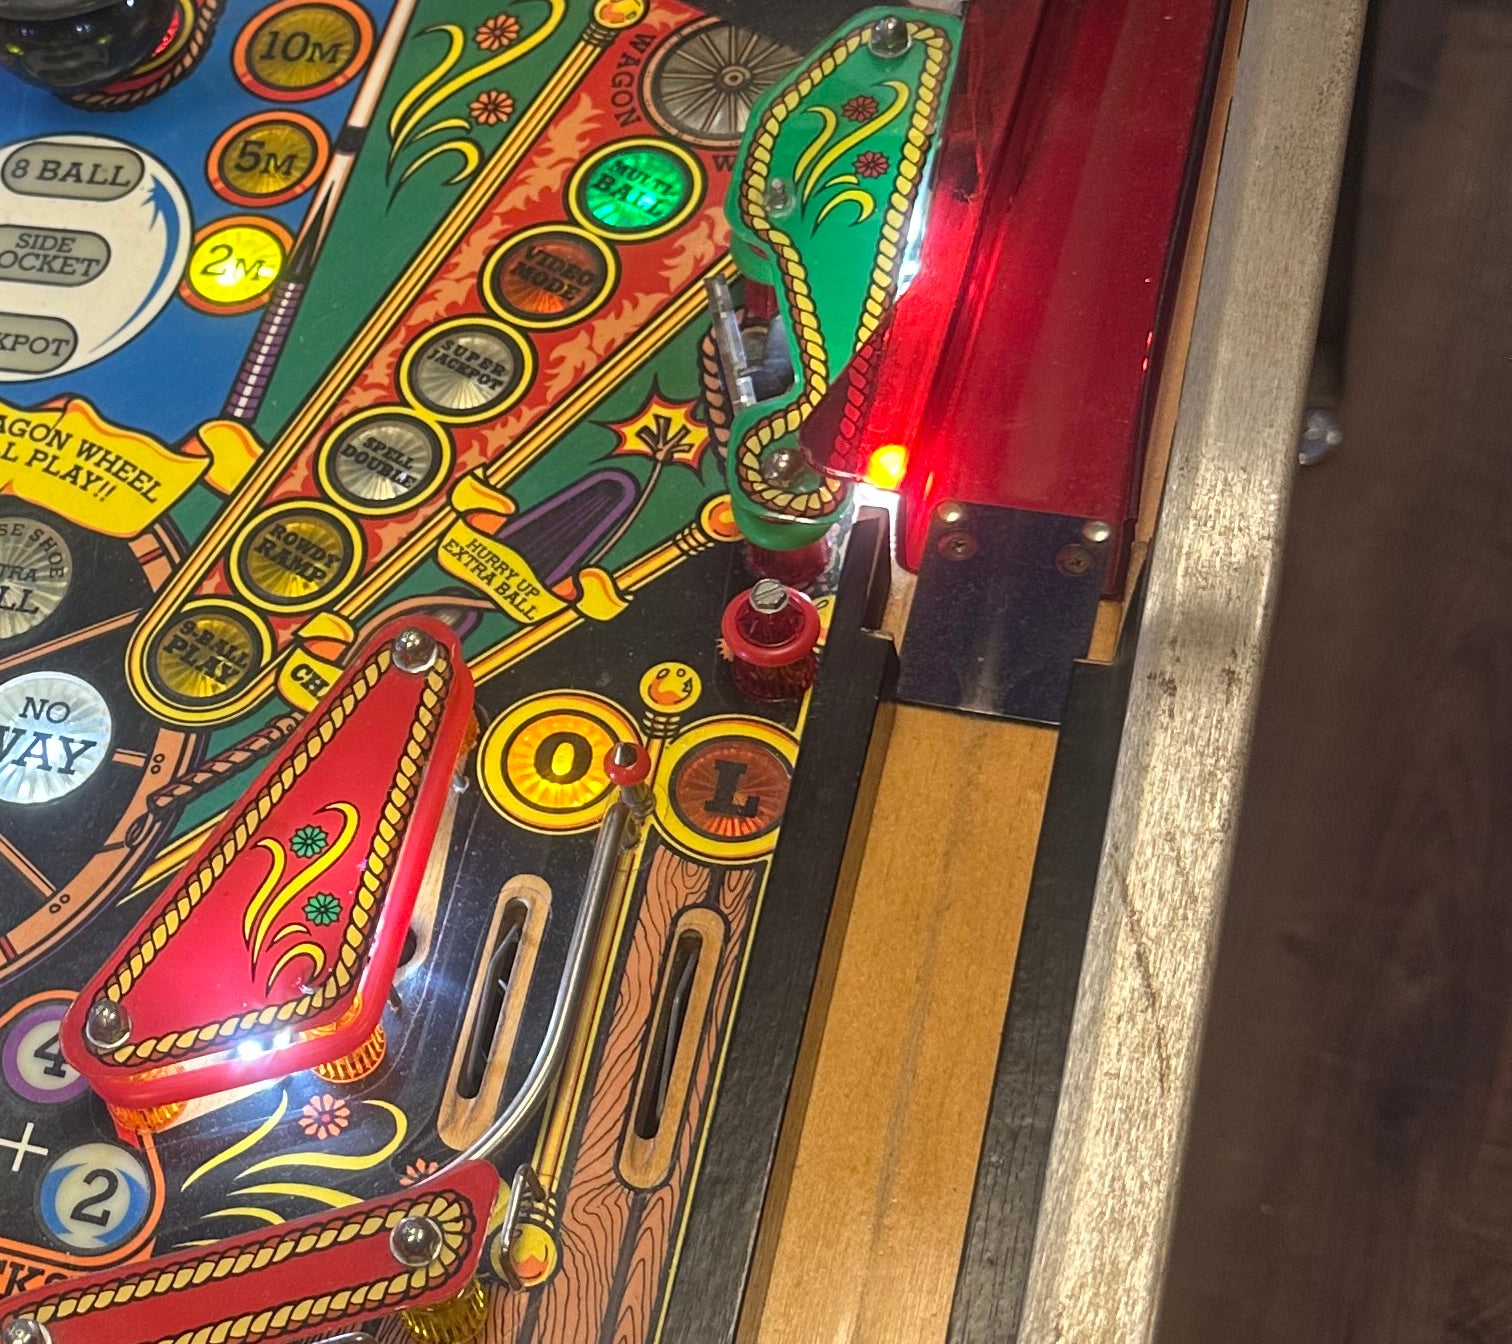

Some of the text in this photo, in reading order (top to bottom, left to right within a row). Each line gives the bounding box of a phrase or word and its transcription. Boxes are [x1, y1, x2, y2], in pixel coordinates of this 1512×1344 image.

[258, 30, 339, 65] 10M
[610, 32, 658, 129] WAGON
[35, 159, 133, 189] BALL
[233, 139, 297, 177] 5M
[608, 159, 675, 197] MULTI
[592, 171, 663, 218] BALL
[14, 232, 77, 254] SIDE
[199, 242, 268, 283] 2M
[524, 244, 597, 286] VIDEO
[510, 259, 582, 304] MODE
[426, 349, 505, 391] JACKPOT
[440, 338, 507, 377] SUPER
[24, 447, 119, 504] PLAY!!
[75, 434, 164, 505] WHEEL
[339, 443, 418, 490] DOUBLE
[362, 436, 415, 470] SPELL
[28, 528, 66, 579] SHOE
[254, 536, 328, 583] RAMP
[270, 522, 341, 569] ROWDY
[465, 536, 541, 599] HURRY UP
[441, 538, 539, 623] EXTRA BALL
[162, 634, 241, 685] PLAY
[19, 695, 72, 724] NO
[69, 1167, 121, 1228] 2
